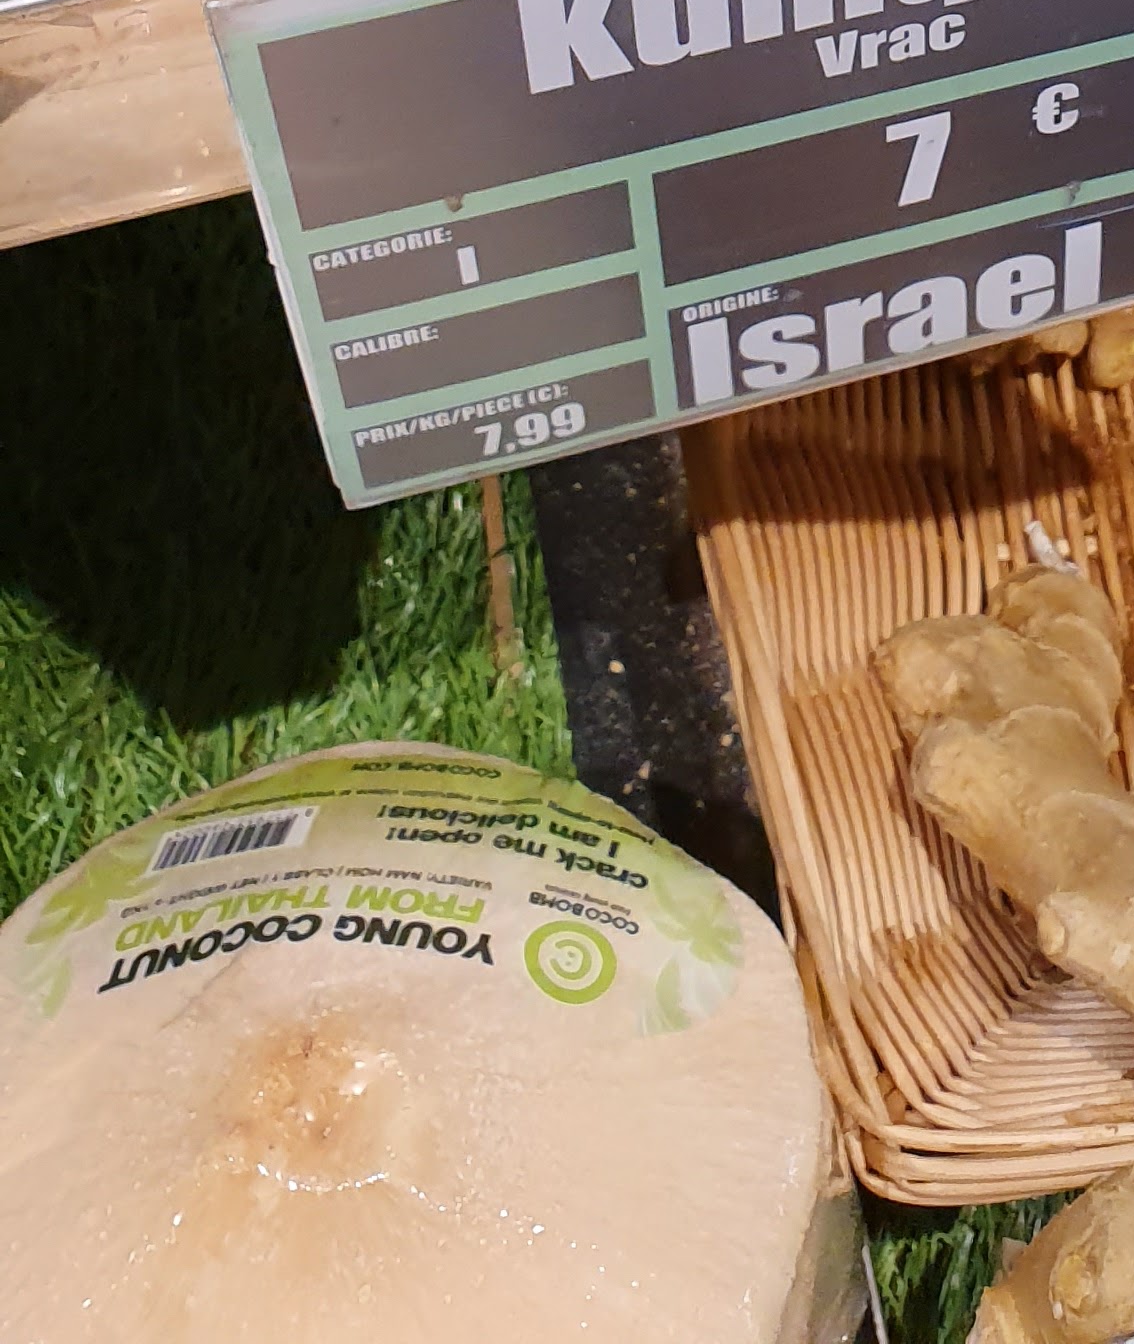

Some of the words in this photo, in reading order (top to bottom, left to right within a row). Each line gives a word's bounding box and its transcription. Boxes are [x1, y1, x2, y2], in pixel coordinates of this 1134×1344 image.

[815, 13, 967, 78] Vrac
[885, 110, 952, 208] 7
[1031, 81, 1081, 135] €
[312, 225, 454, 273] CATEGORIE:
[682, 285, 780, 323] ORIGINE:
[687, 221, 1103, 408] Israel
[334, 325, 440, 362] CALIBRE:
[473, 401, 587, 457] 7.99
[376, 804, 542, 831] delicious!
[384, 826, 484, 846] open!
[548, 820, 602, 849] am
[492, 834, 548, 859] me
[554, 848, 650, 891] crack
[114, 884, 332, 953] THAILAND
[346, 884, 486, 925] FROM
[98, 913, 323, 995] COCONUT
[334, 913, 495, 966] YOUNG
